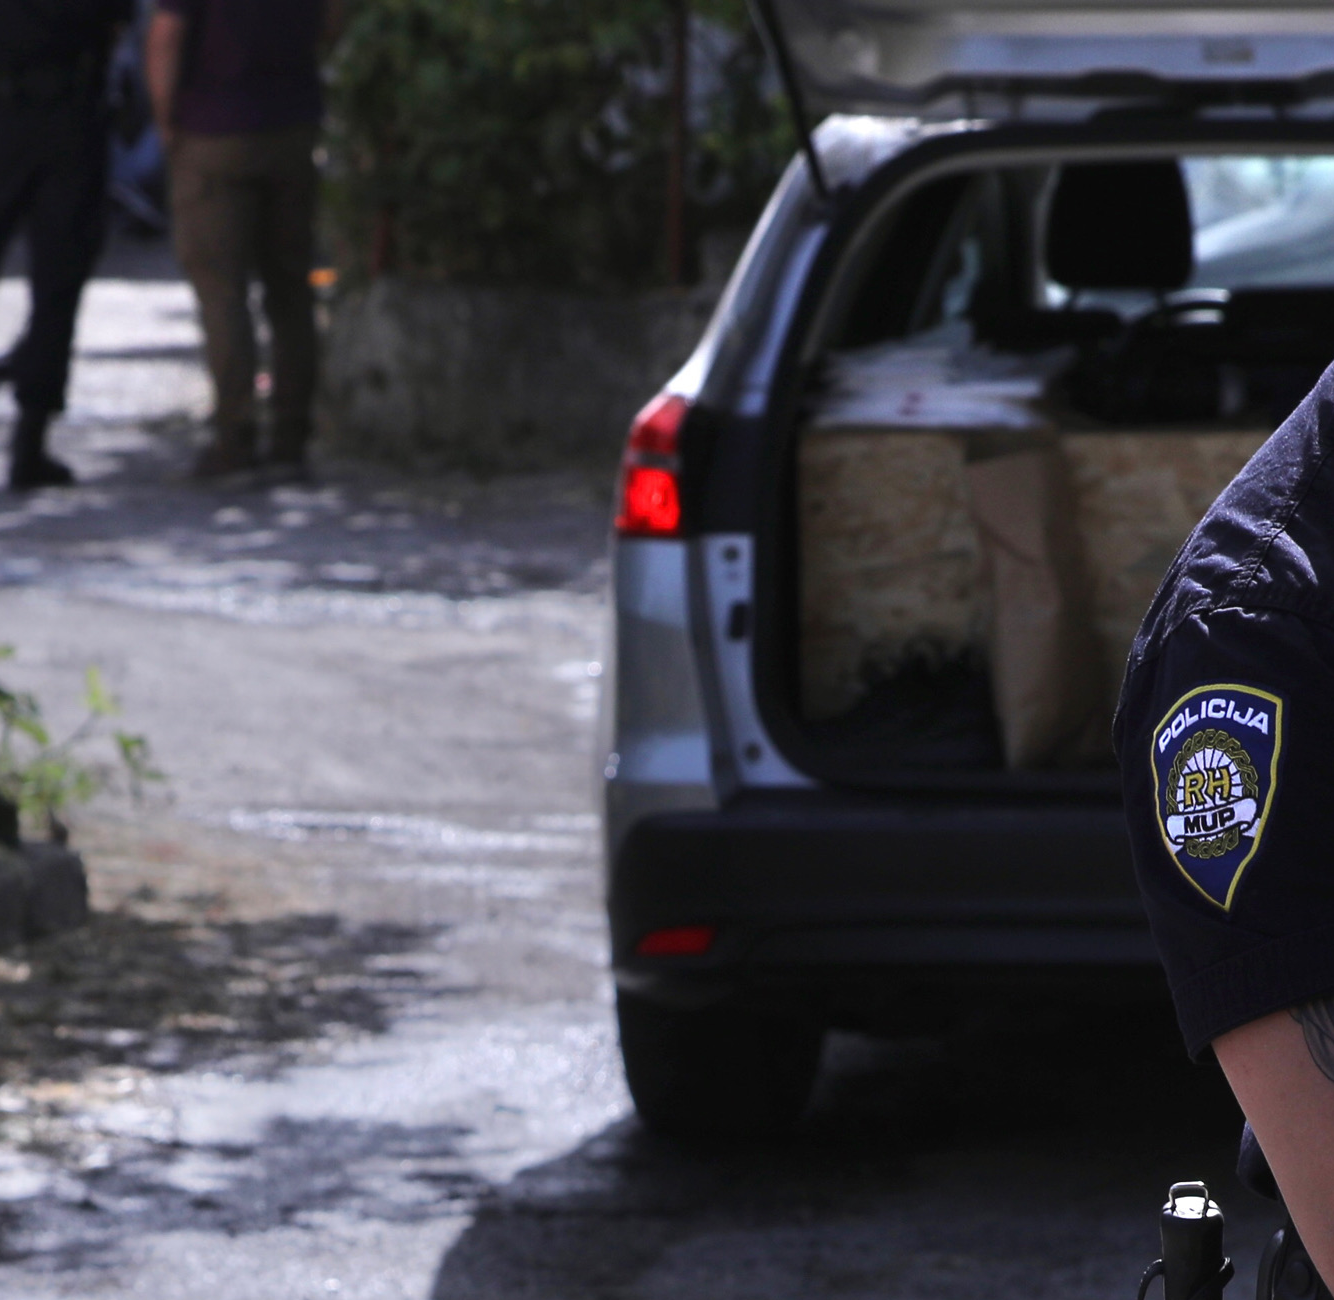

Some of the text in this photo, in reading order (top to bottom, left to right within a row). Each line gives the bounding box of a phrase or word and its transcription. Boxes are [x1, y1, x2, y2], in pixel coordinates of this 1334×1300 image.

[1158, 698, 1270, 753] POLICIJA
[1184, 767, 1232, 807] RH
[1184, 806, 1236, 834] MUP
